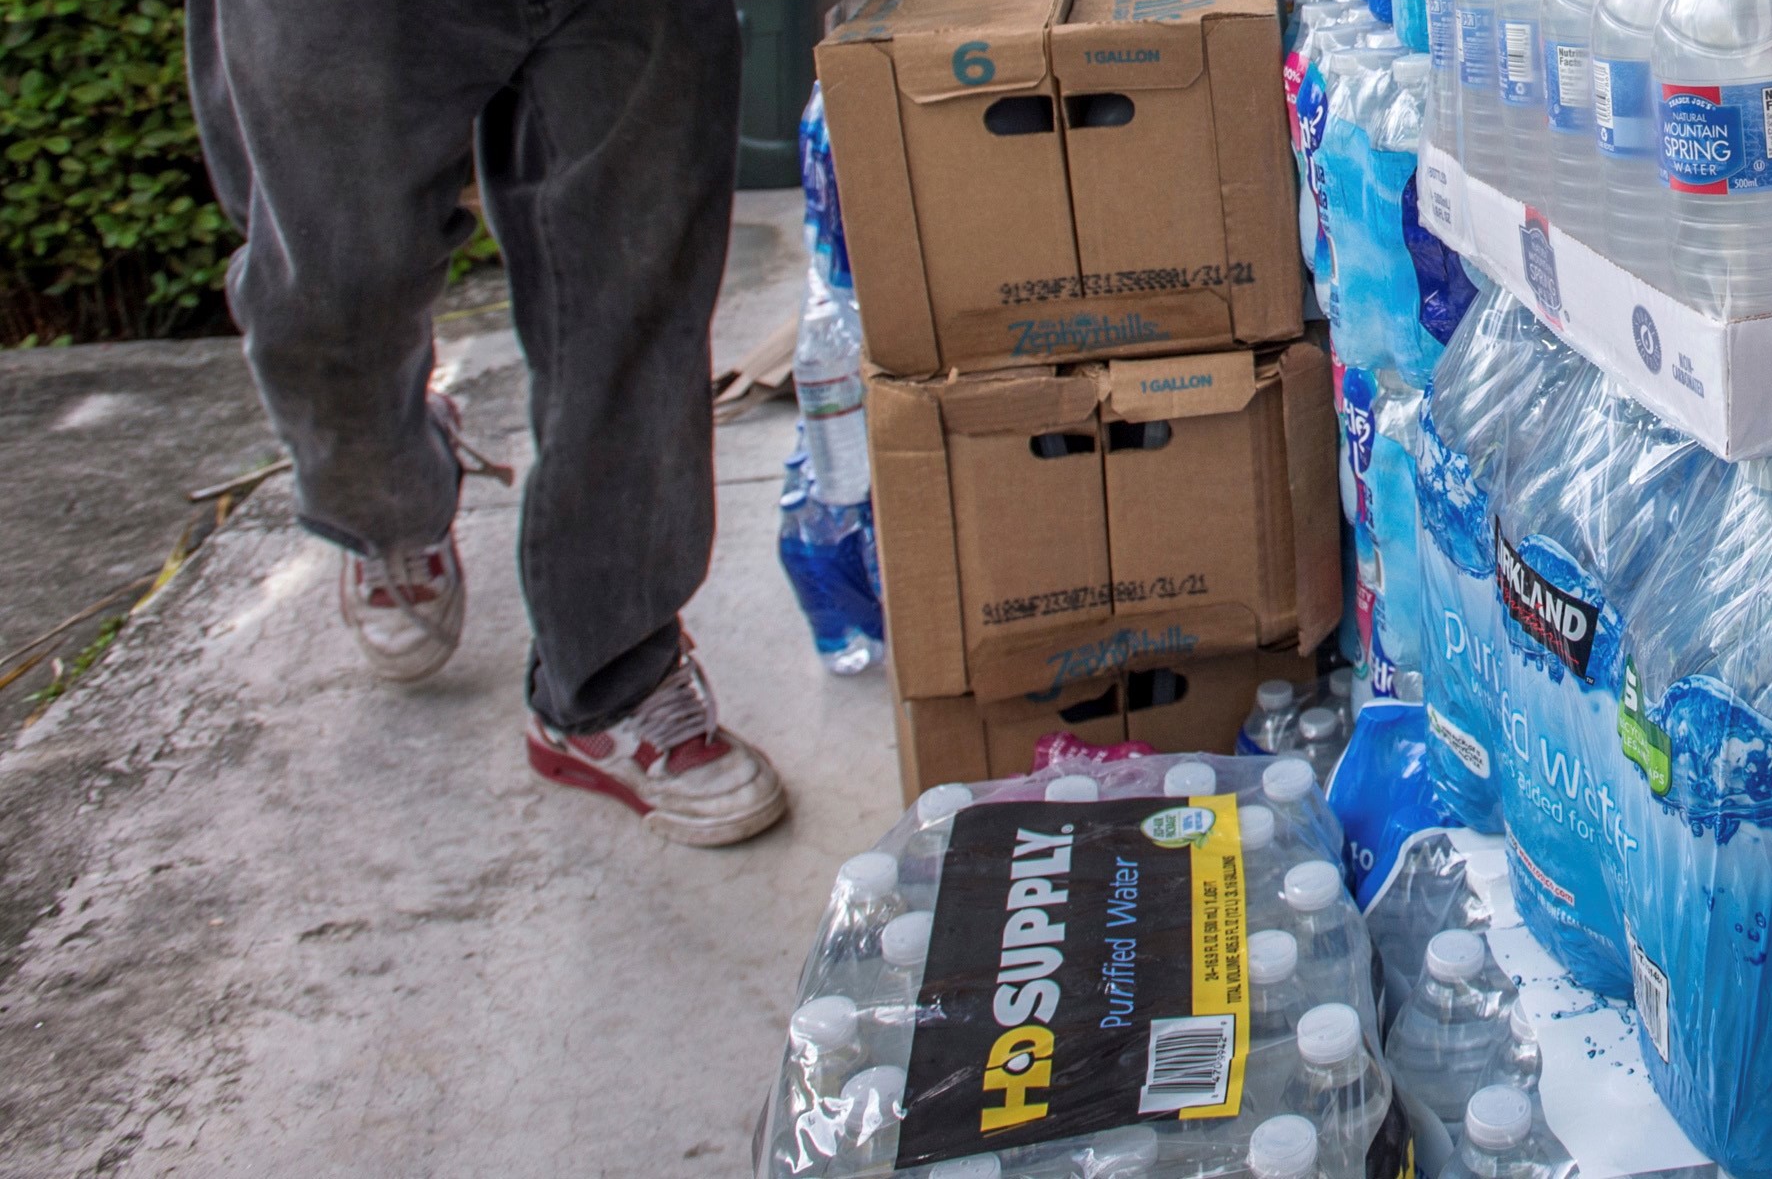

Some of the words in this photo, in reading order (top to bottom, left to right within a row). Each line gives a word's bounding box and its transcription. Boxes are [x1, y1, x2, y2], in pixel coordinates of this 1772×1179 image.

[951, 40, 997, 87] 6
[1094, 49, 1161, 65] GALLON
[1663, 121, 1729, 139] MOUNTAIN
[1672, 111, 1708, 123] NATURAL
[1664, 136, 1732, 162] SPRING
[1673, 160, 1718, 176] WATER
[1007, 312, 1152, 359] Zephyrhills
[1149, 374, 1214, 395] GALLON
[1517, 770, 1563, 824] added
[1567, 808, 1596, 844] for
[1106, 855, 1140, 929] Water
[1100, 937, 1137, 1030] Purified
